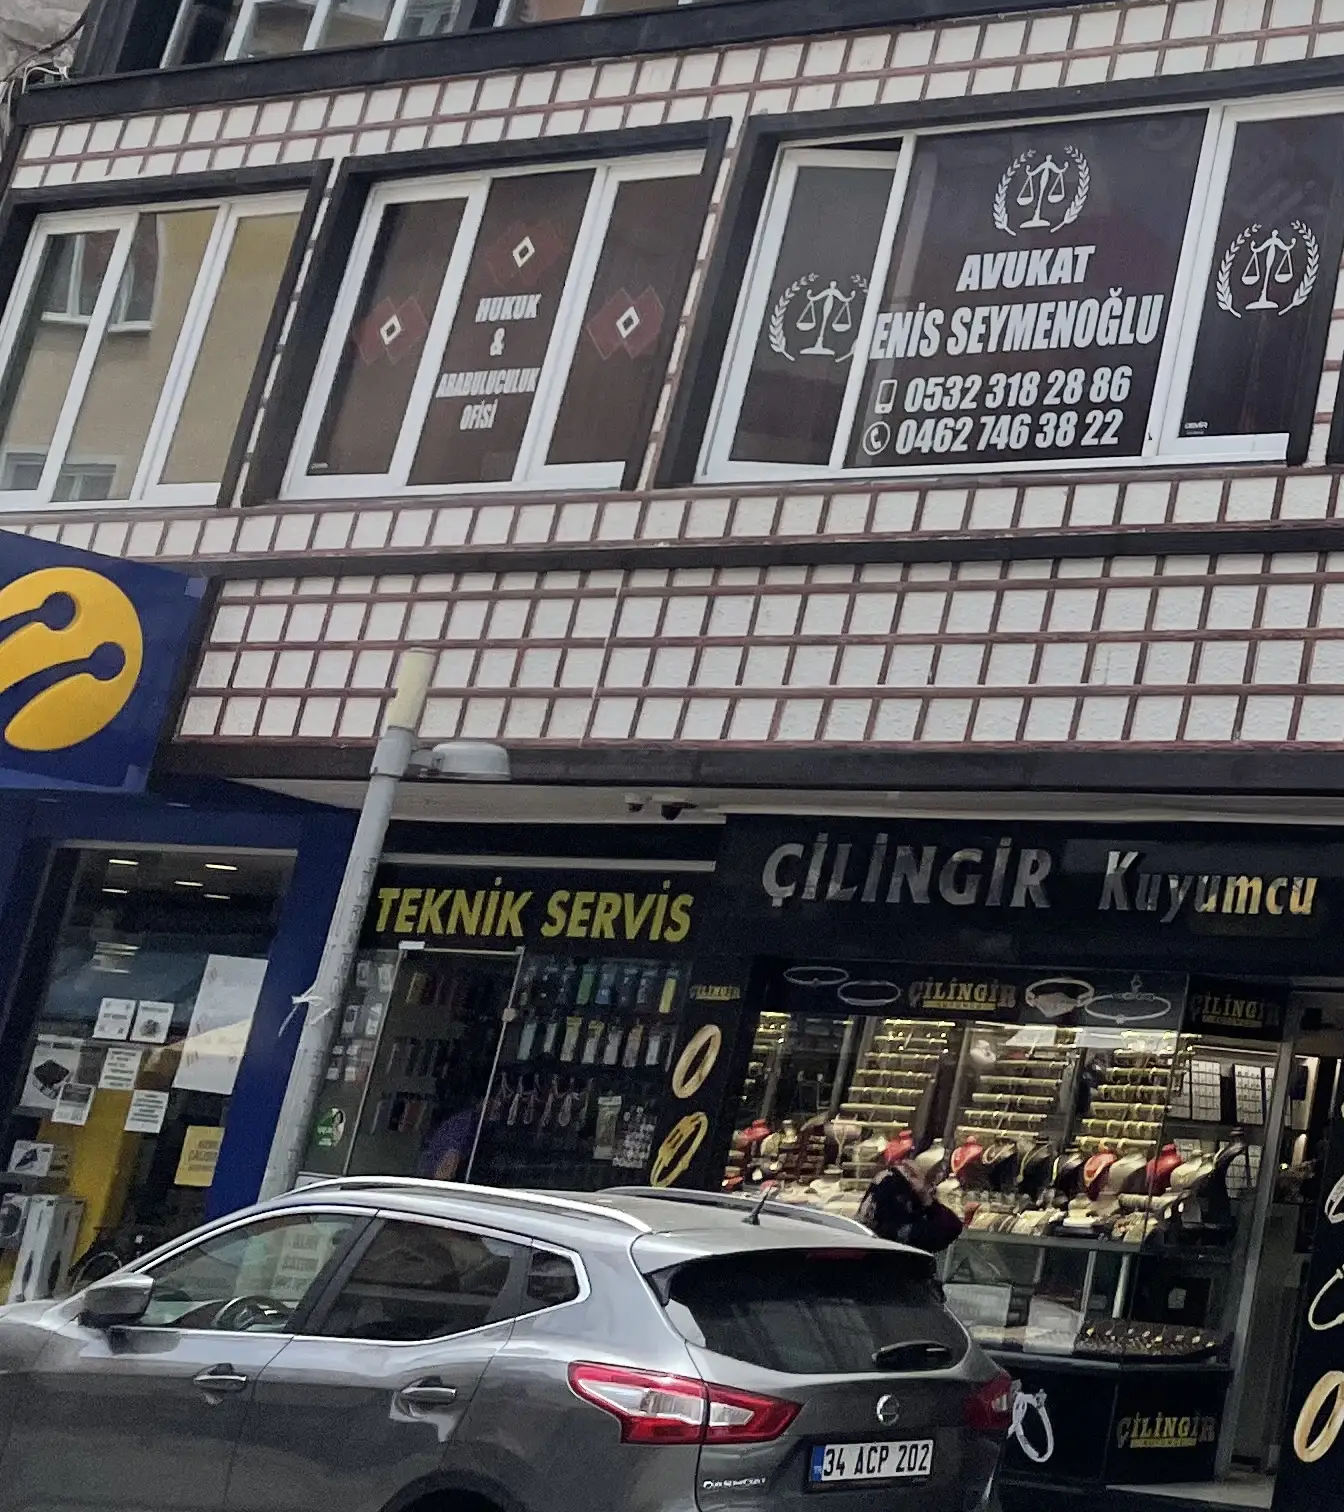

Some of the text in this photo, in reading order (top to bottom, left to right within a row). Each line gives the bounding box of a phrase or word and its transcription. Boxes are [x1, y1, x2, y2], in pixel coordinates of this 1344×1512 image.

[956, 244, 1095, 292] AVUKAT
[475, 293, 543, 323] HUKUK
[869, 287, 1165, 361] ENİS SEYMENOĞLU
[903, 365, 1133, 414] 0532 318 28 86
[460, 398, 499, 431] OFİSİ
[895, 408, 1122, 456] 0462 746 38 22
[762, 832, 1319, 923] ÇİLİNGİR Kuyumcu
[374, 876, 532, 938] TEKNİK
[540, 879, 694, 942] SERVİS
[823, 1448, 845, 1476] 34
[854, 1445, 889, 1475] ACP
[895, 1443, 930, 1473] 202
